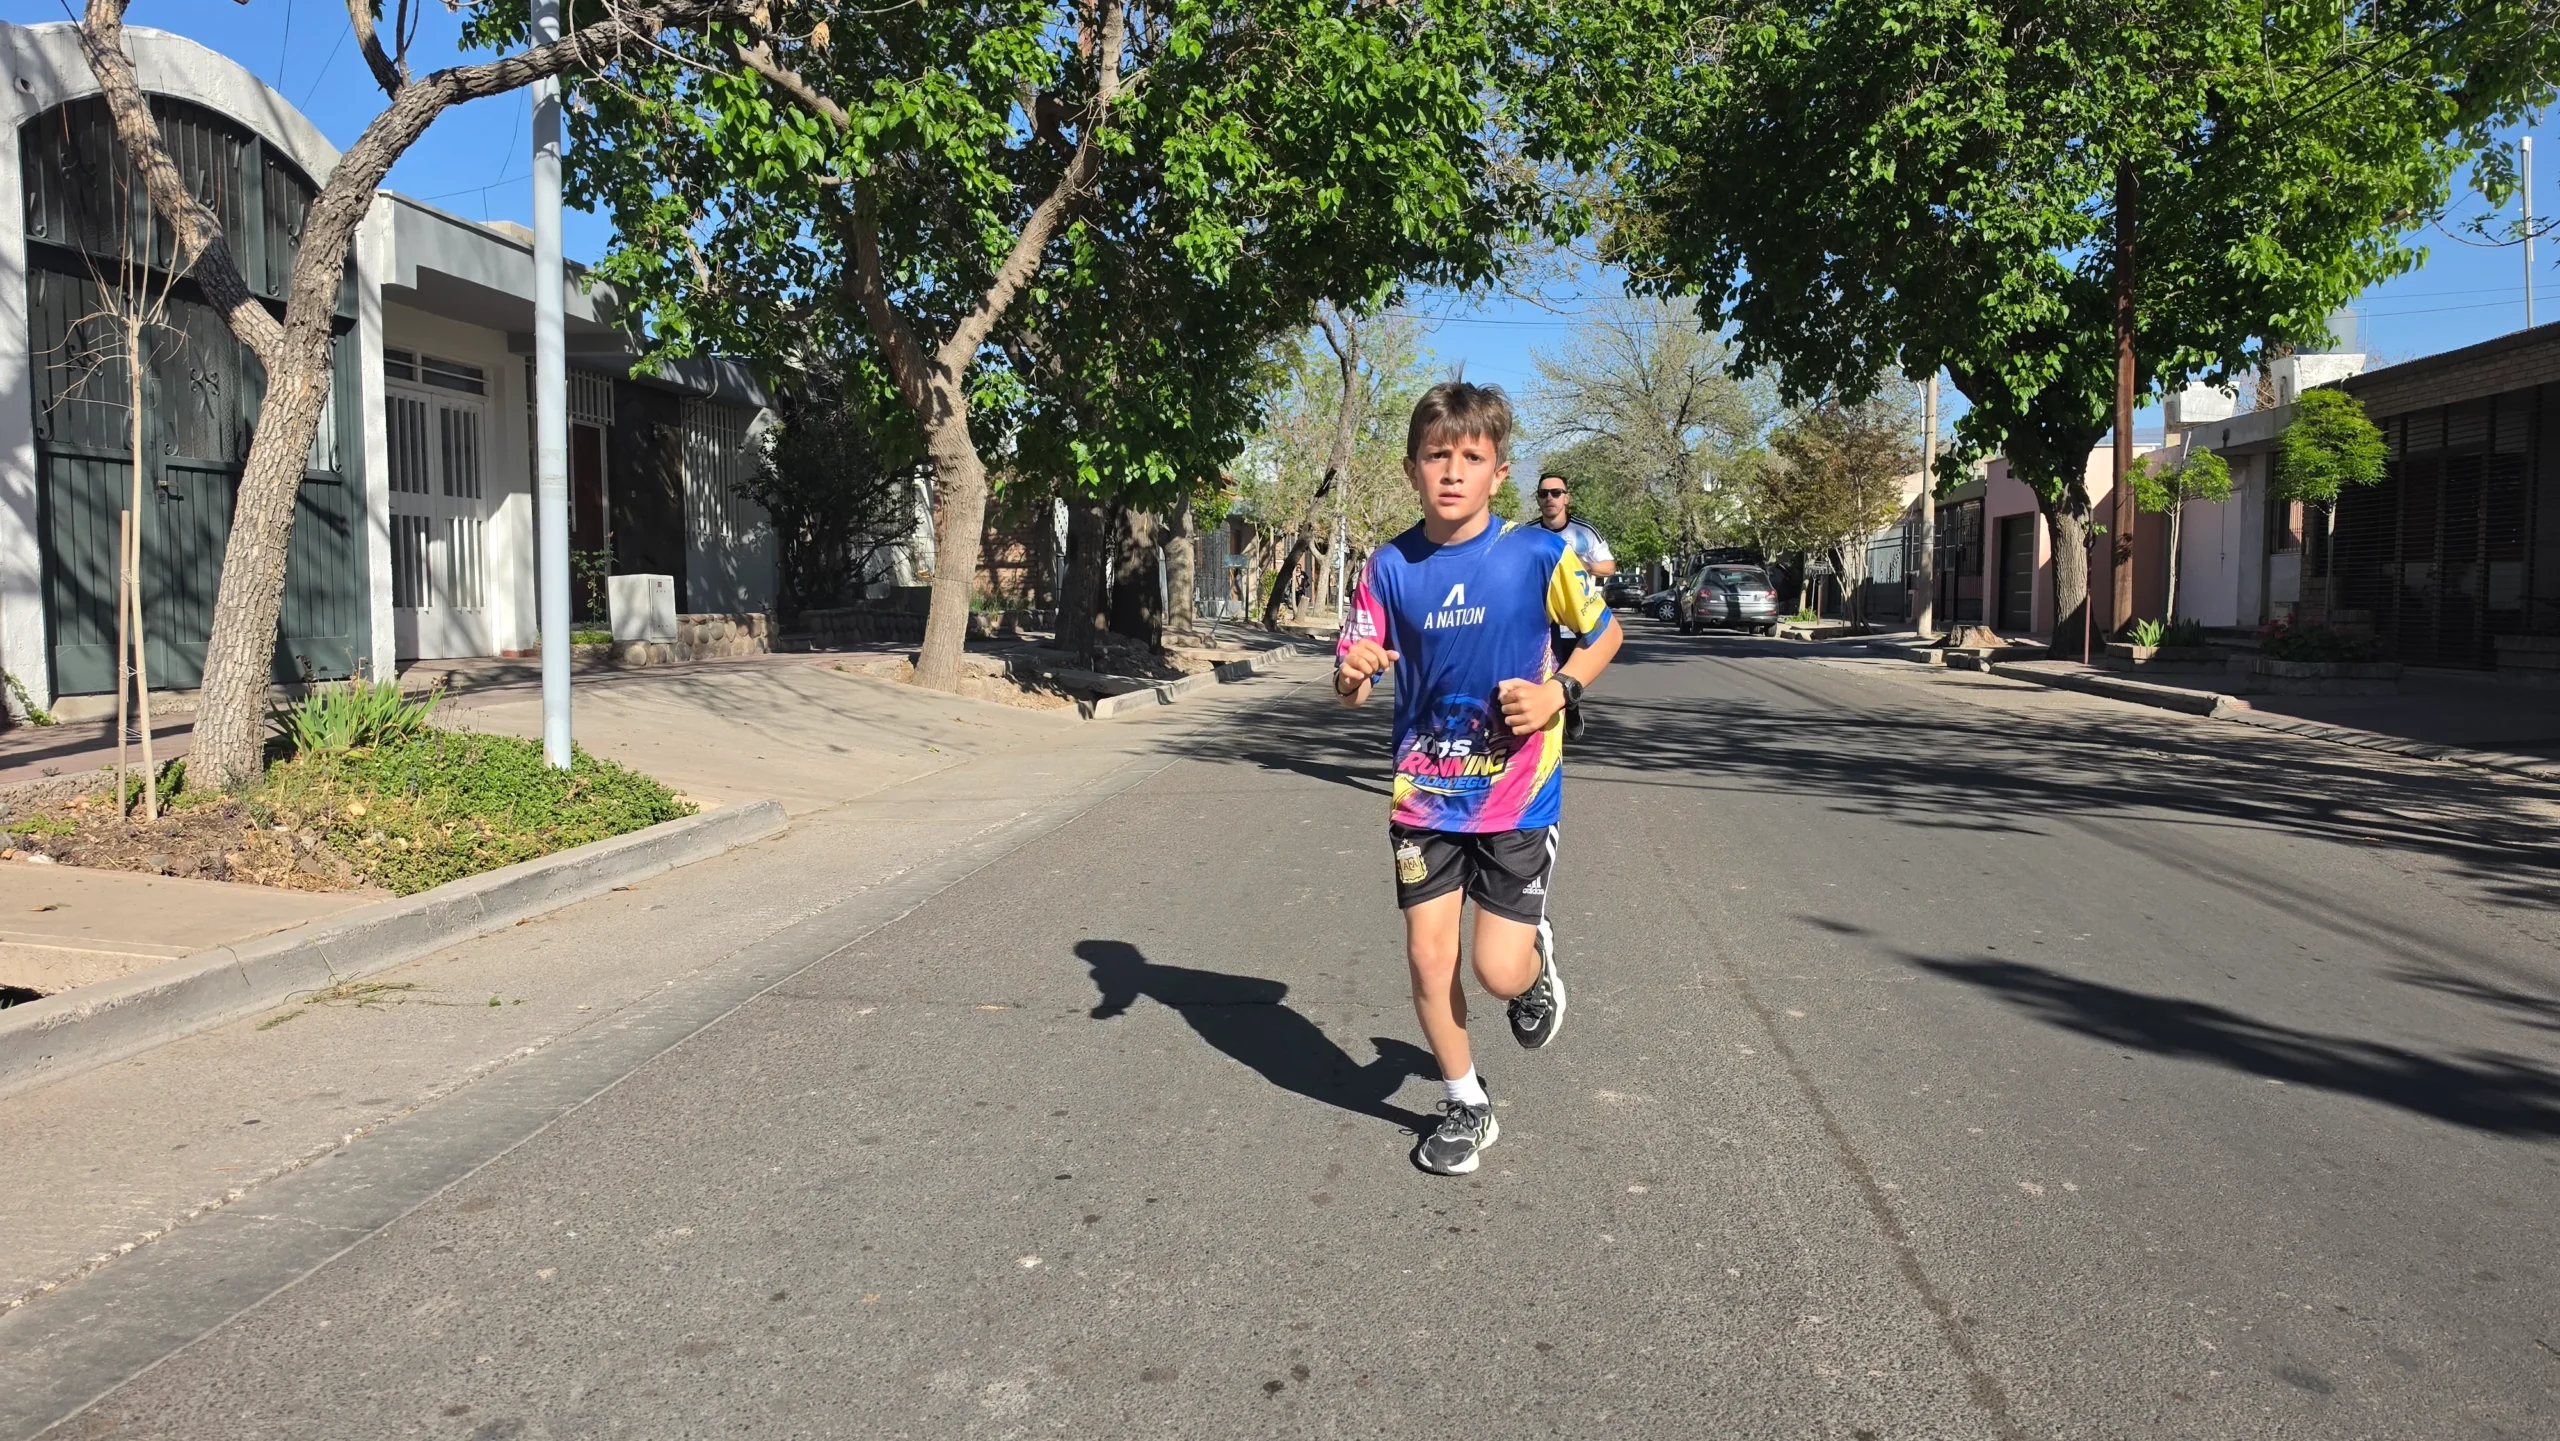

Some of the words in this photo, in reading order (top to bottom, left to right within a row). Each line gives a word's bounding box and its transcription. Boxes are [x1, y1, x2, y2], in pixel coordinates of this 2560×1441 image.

[1423, 611, 1433, 629] A
[1436, 606, 1486, 628] NATION
[1397, 748, 1507, 777] RUNNING
[1522, 887, 1545, 895] adidas
